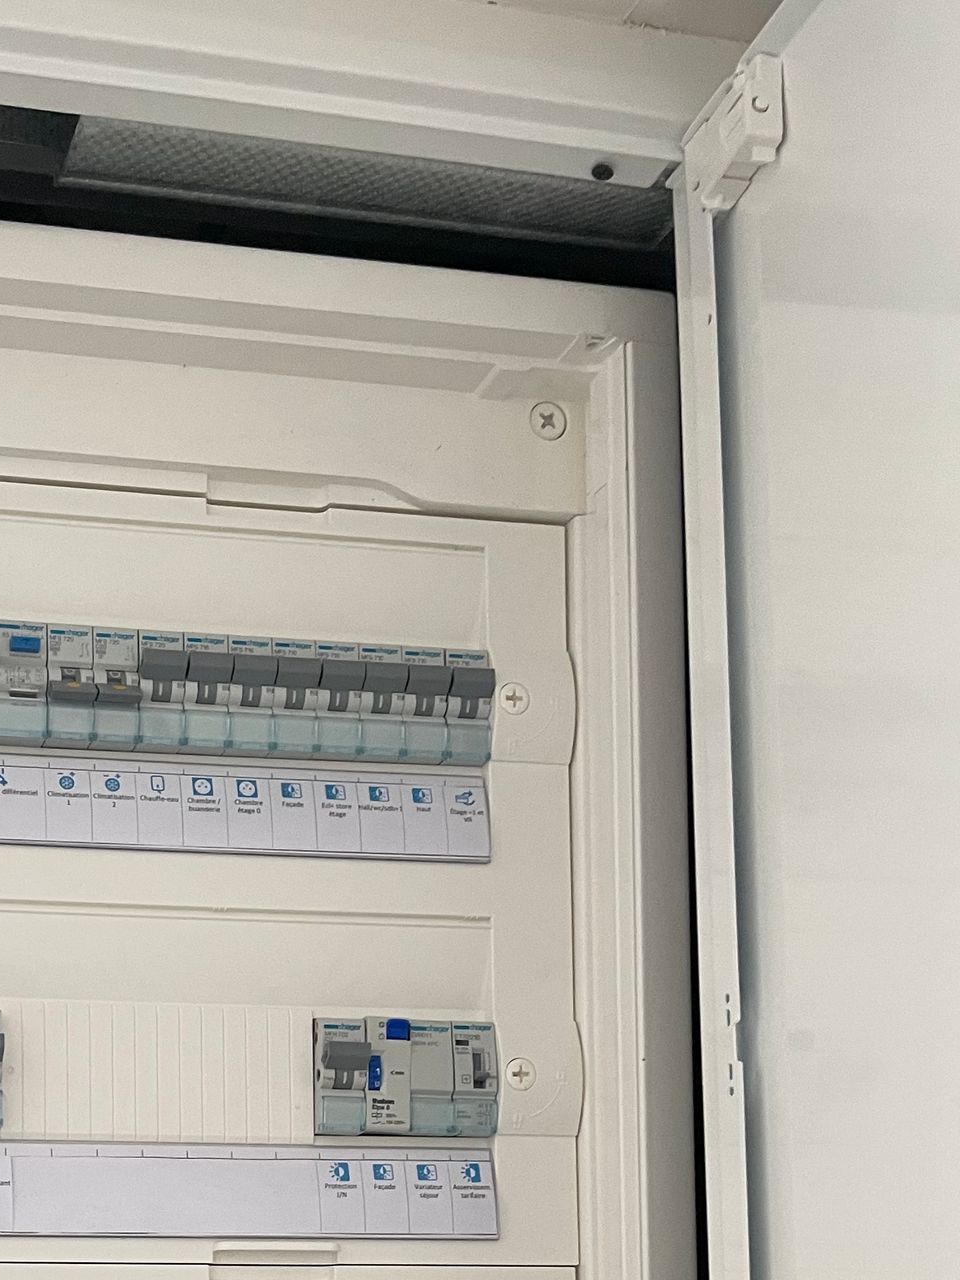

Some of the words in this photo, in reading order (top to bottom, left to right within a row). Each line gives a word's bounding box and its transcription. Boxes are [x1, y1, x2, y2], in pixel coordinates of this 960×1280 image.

[1, 788, 38, 797] différentiel
[47, 790, 90, 799] Climatisation
[93, 792, 135, 801] Climatisation
[140, 794, 179, 803] Chauffe-eau
[187, 797, 216, 805] Chambre
[234, 799, 263, 807] Chambre
